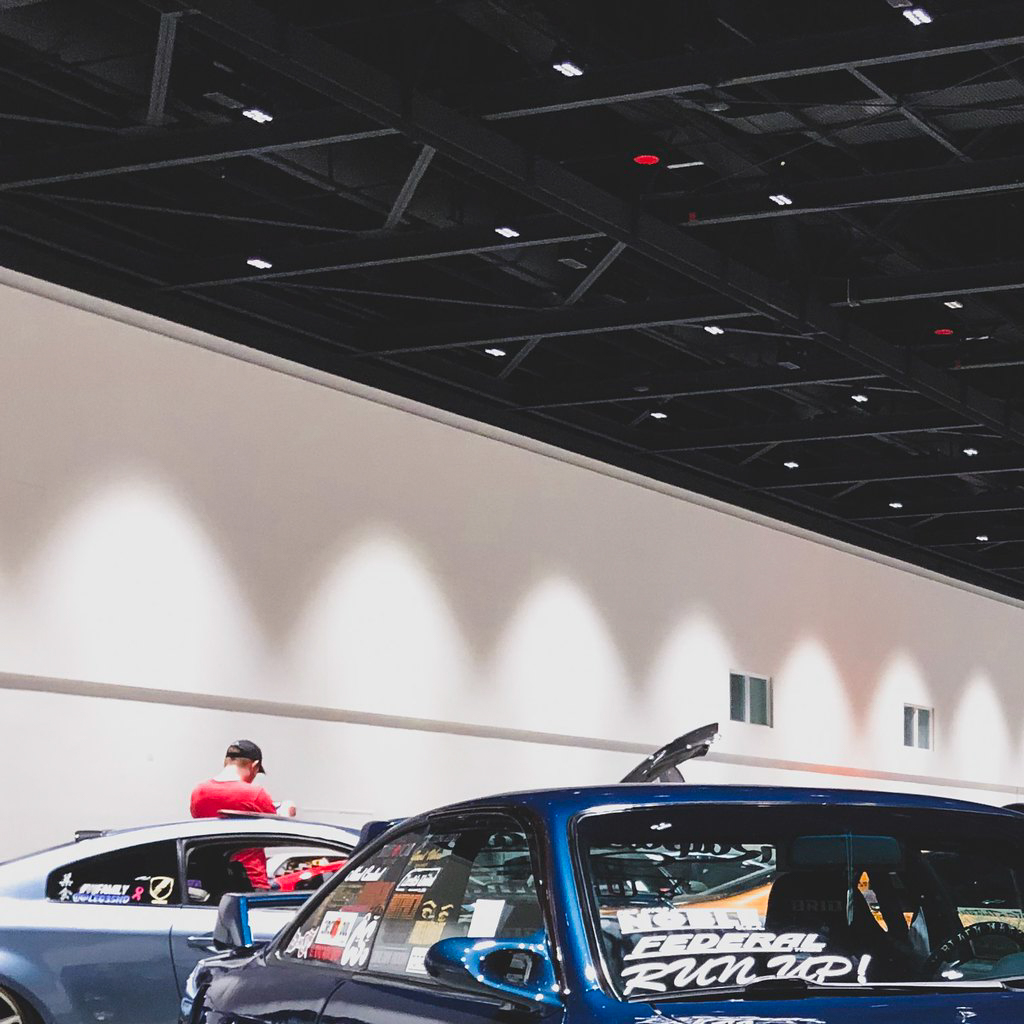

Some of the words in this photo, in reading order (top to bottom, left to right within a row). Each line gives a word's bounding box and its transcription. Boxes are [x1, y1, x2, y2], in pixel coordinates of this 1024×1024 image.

[628, 932, 827, 959] FEDERAL
[620, 955, 757, 995] RUN
[766, 954, 872, 985] UP!
